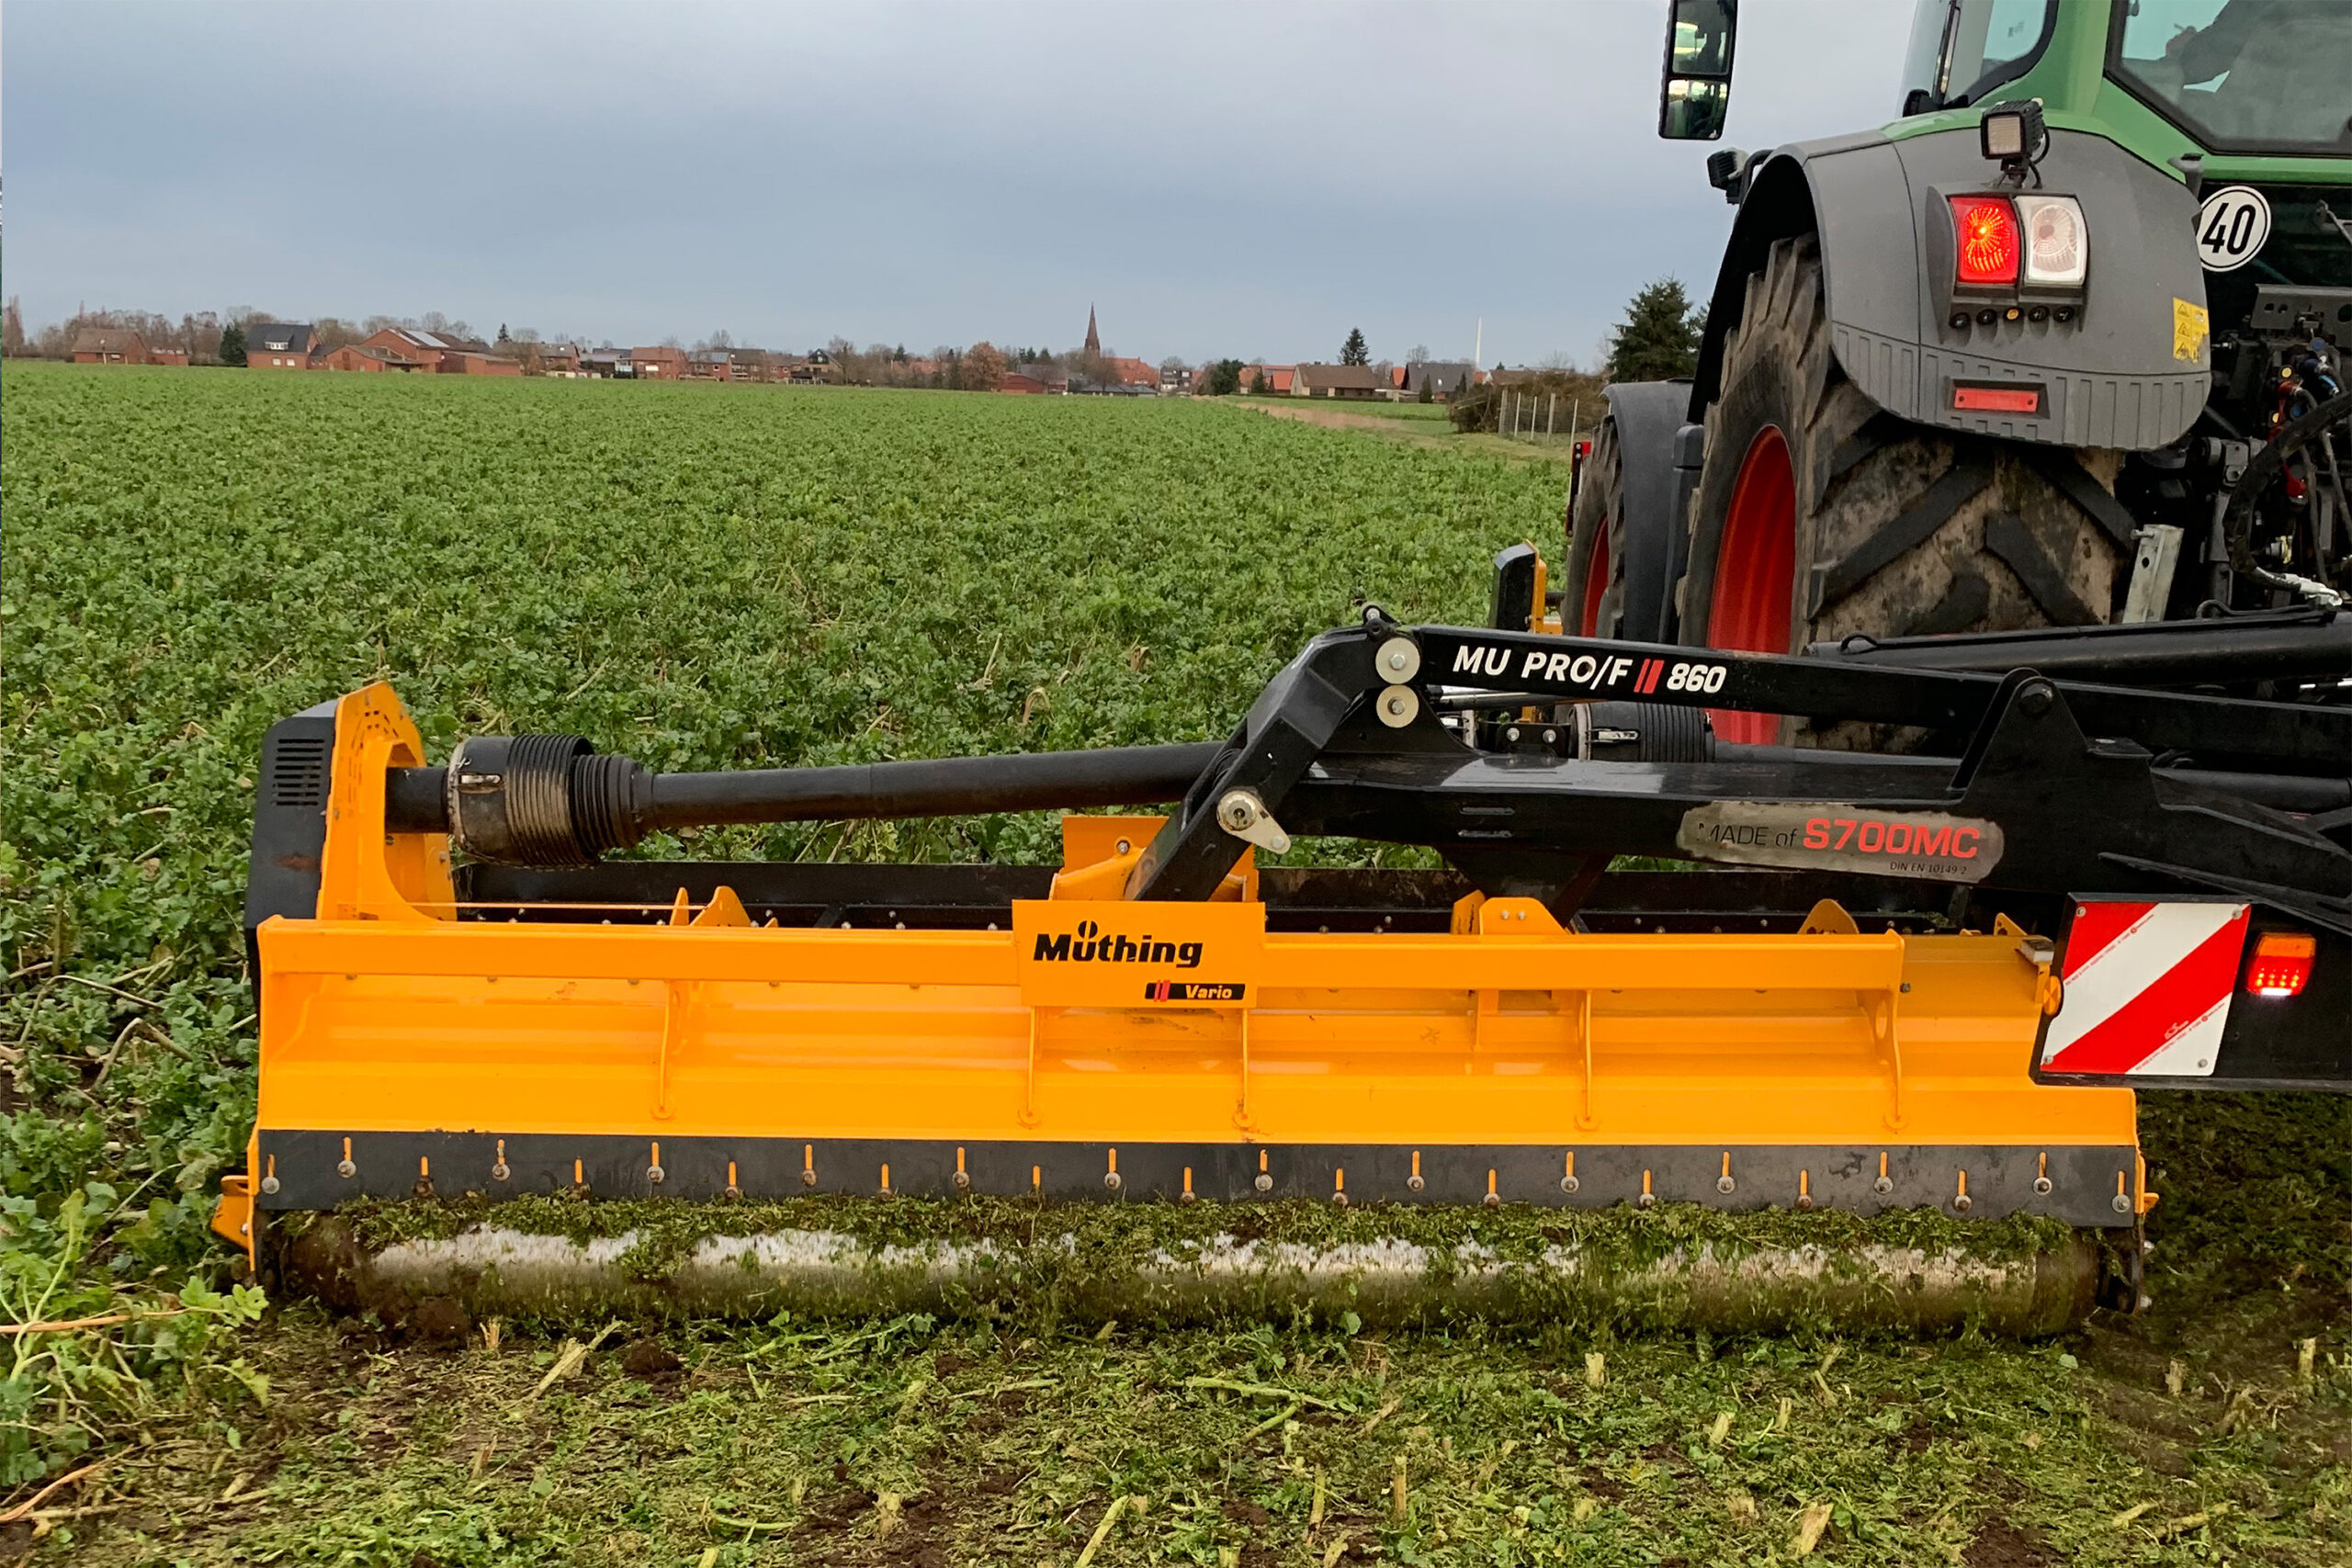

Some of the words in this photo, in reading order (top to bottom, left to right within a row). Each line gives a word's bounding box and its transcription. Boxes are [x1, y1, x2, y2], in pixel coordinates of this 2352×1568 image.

[2200, 202, 2256, 255] 40
[1453, 645, 1511, 676] MU
[1521, 651, 1634, 691] PRO/F
[1666, 663, 1727, 694] 860
[1775, 828, 1798, 847] of
[1804, 818, 1980, 859] S700MC
[1889, 862, 1908, 871] DIN
[1911, 863, 1926, 872] EN
[1185, 984, 1233, 999] Vario
